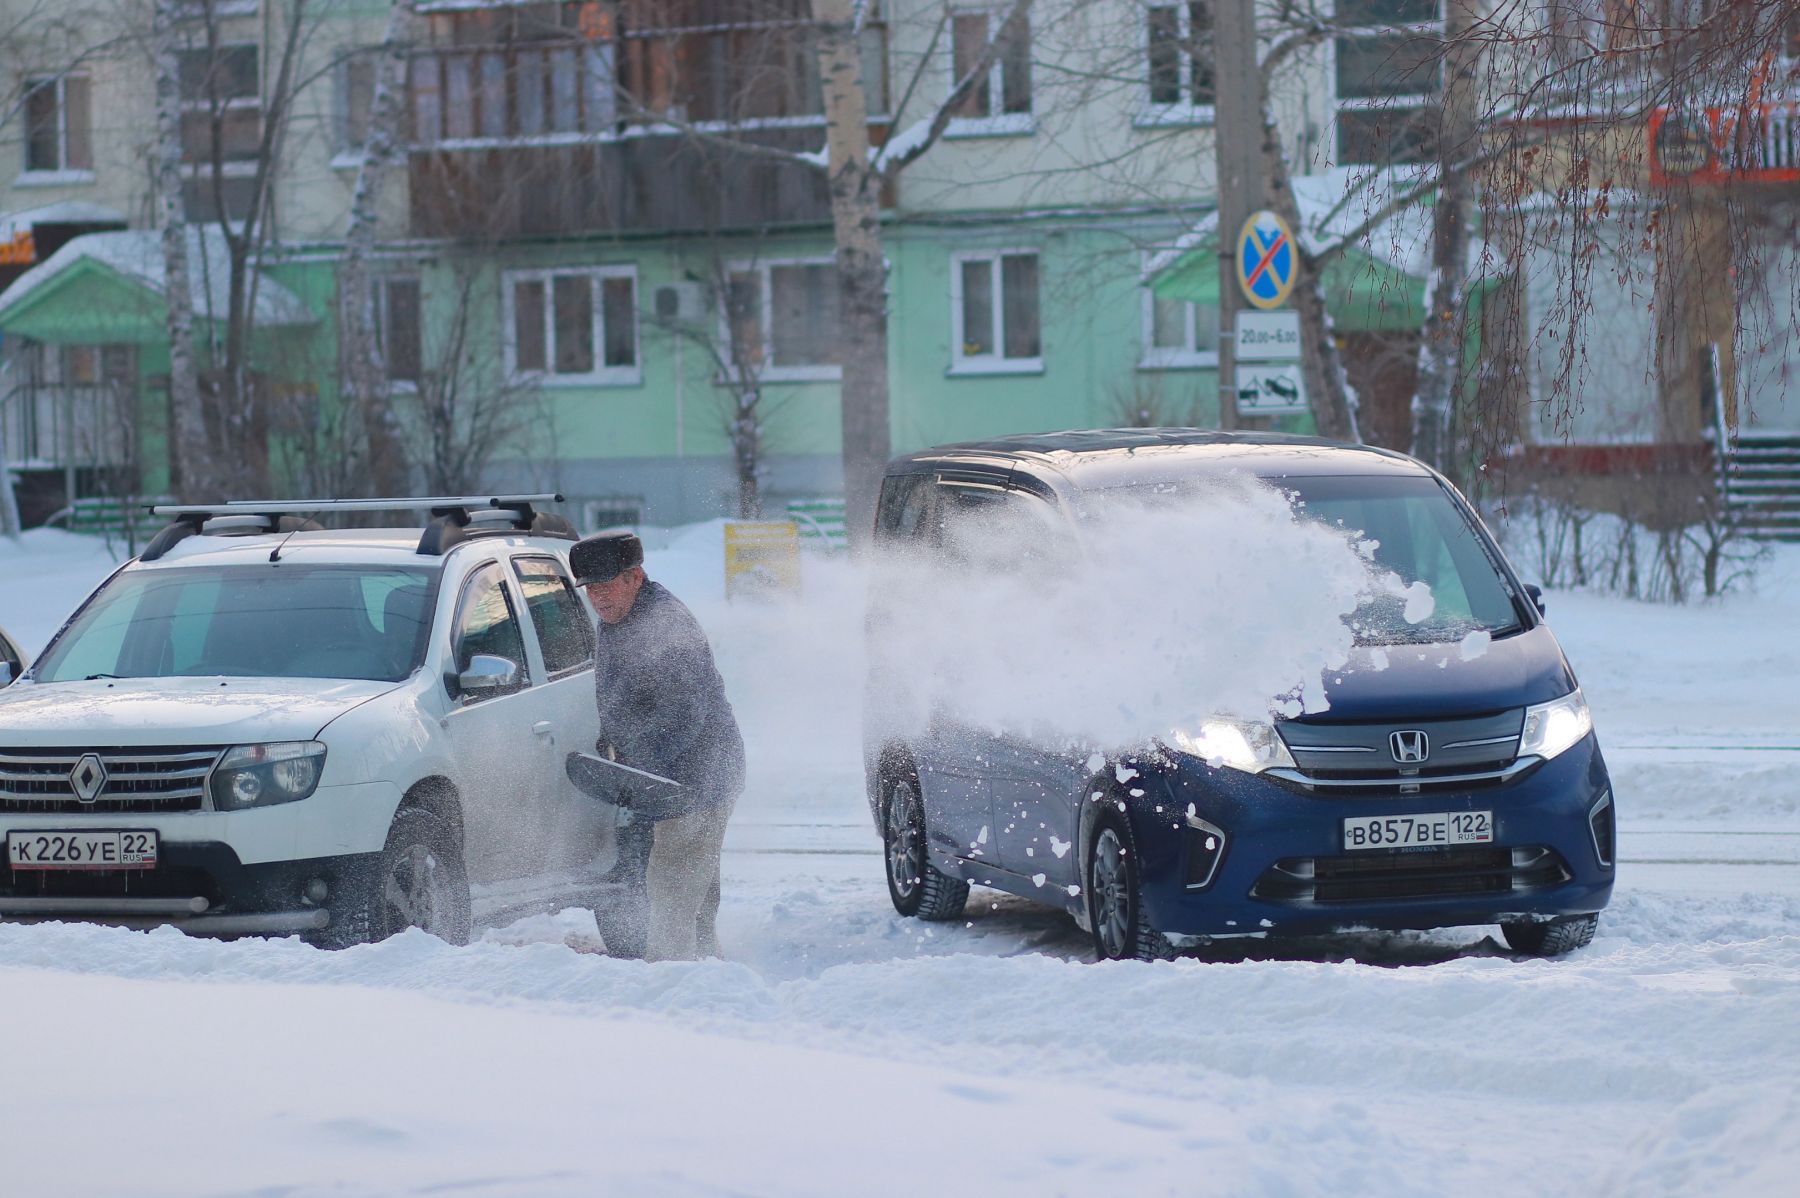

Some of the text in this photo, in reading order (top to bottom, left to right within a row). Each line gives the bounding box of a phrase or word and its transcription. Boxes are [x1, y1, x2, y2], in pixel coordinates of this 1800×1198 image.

[1451, 814, 1486, 833] 122
[1458, 832, 1476, 840] RUS
[123, 834, 148, 853] 22
[122, 854, 142, 862] RUS
